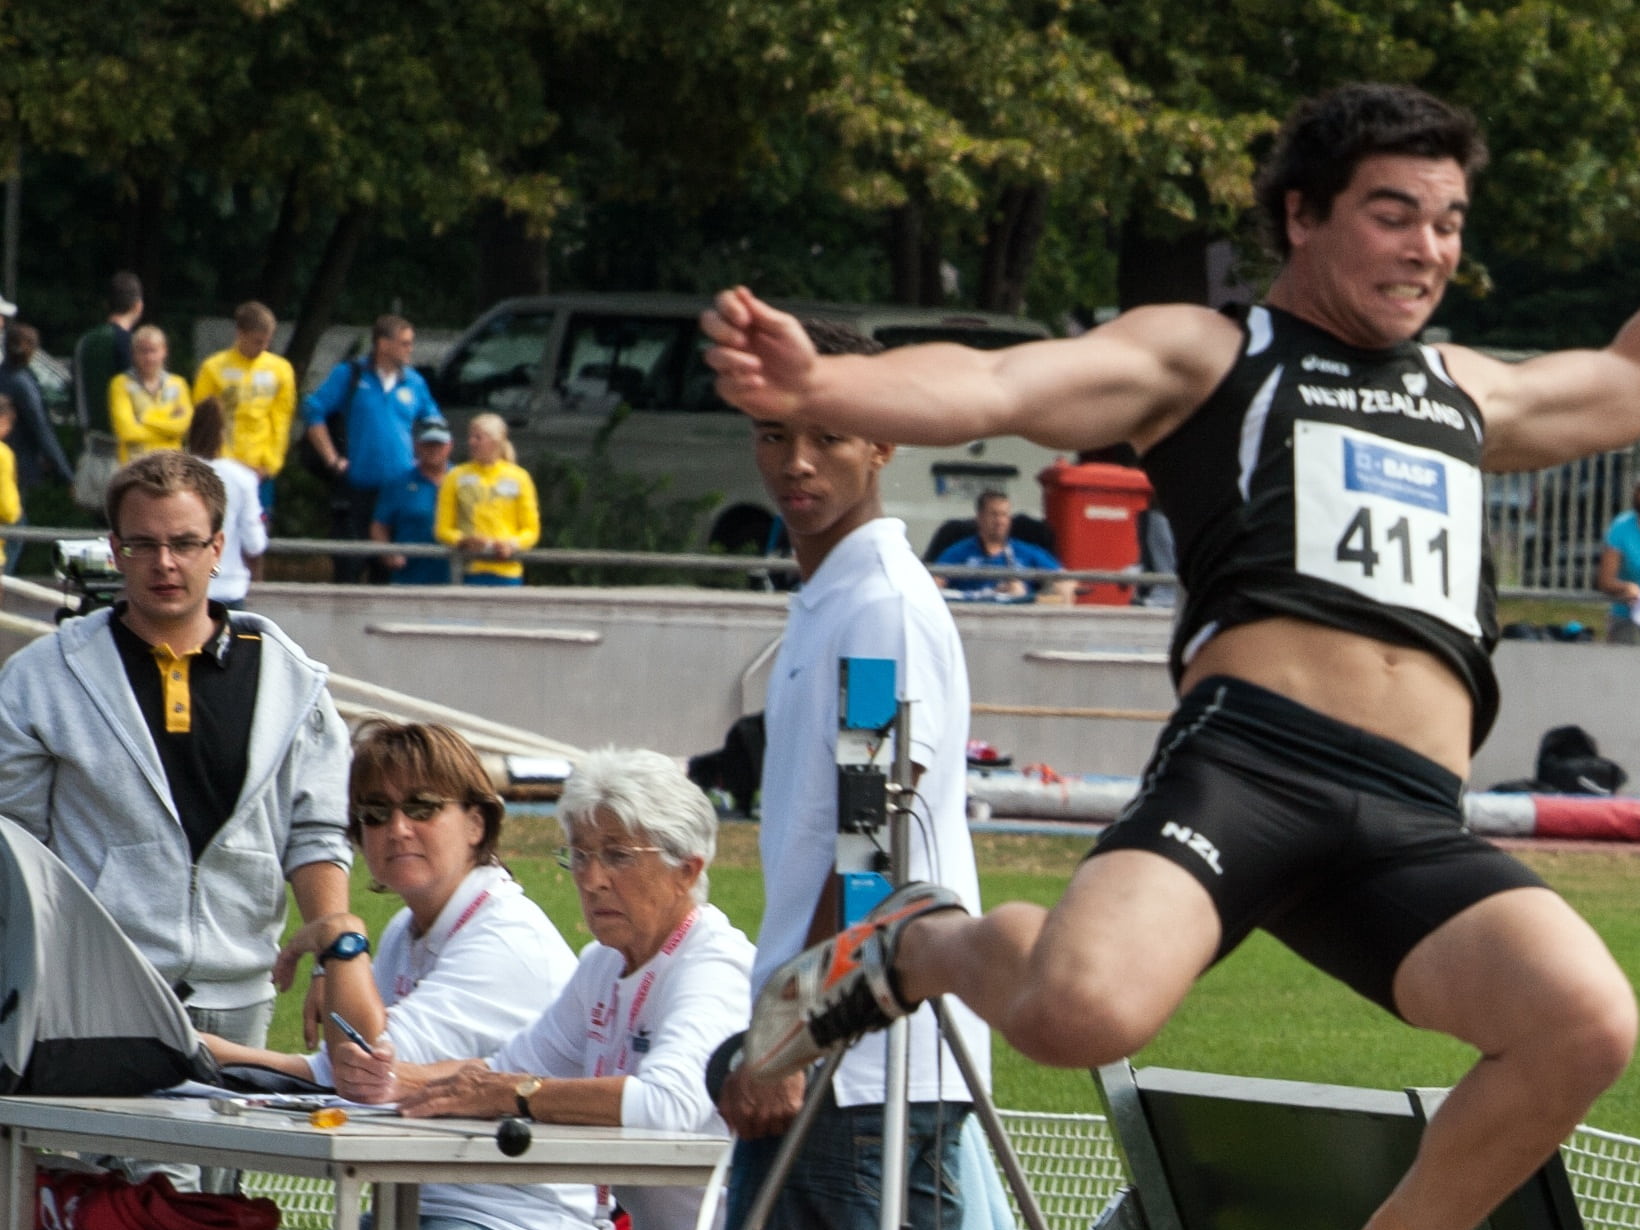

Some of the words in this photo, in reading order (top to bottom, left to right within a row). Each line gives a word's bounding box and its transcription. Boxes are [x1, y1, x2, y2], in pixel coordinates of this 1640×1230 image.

[1298, 384, 1357, 412] NEW
[1358, 387, 1466, 431] ZEALAND
[1381, 457, 1438, 487] BASF
[1335, 507, 1450, 599] 411
[1161, 821, 1224, 875] NZL
